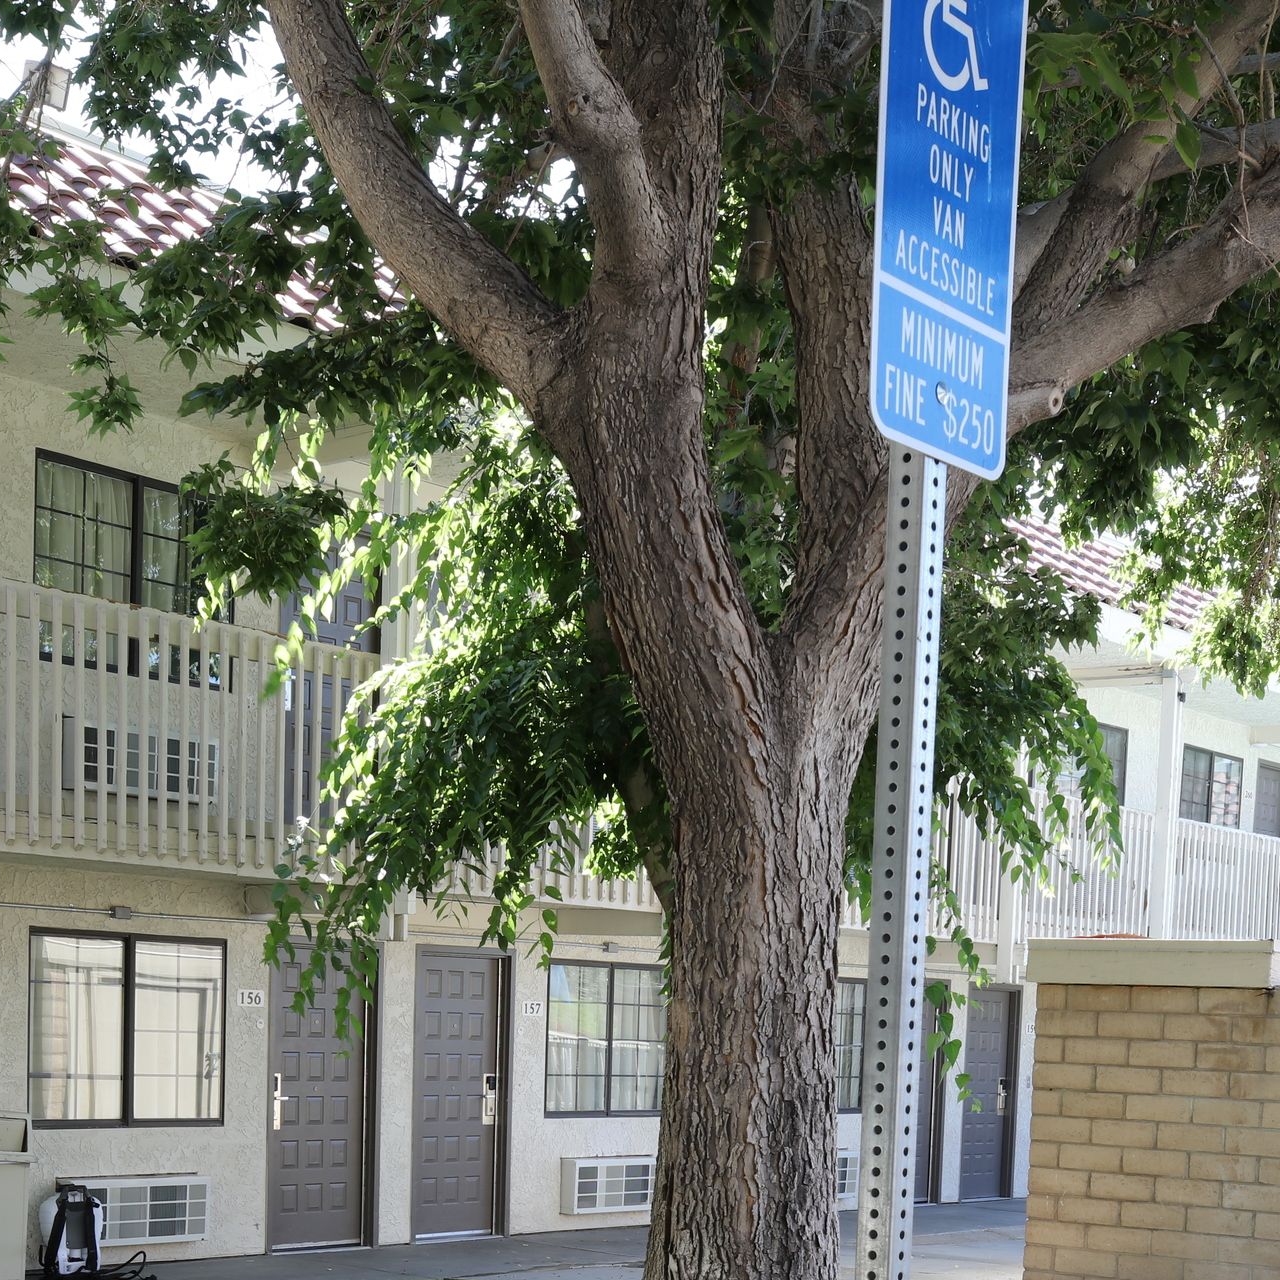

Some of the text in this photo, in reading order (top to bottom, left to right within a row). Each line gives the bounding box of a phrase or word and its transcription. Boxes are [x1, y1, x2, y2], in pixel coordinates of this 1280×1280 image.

[917, 82, 989, 163] PARKING
[929, 143, 974, 202] ONLY
[933, 195, 965, 250] VAN
[895, 229, 995, 317] ACCESSIBLE
[901, 306, 984, 390] MINIMUM
[884, 363, 995, 455] FINE $250
[240, 991, 261, 1005] 156
[524, 1003, 541, 1015] 157
[1027, 1024, 1036, 1034] 15
